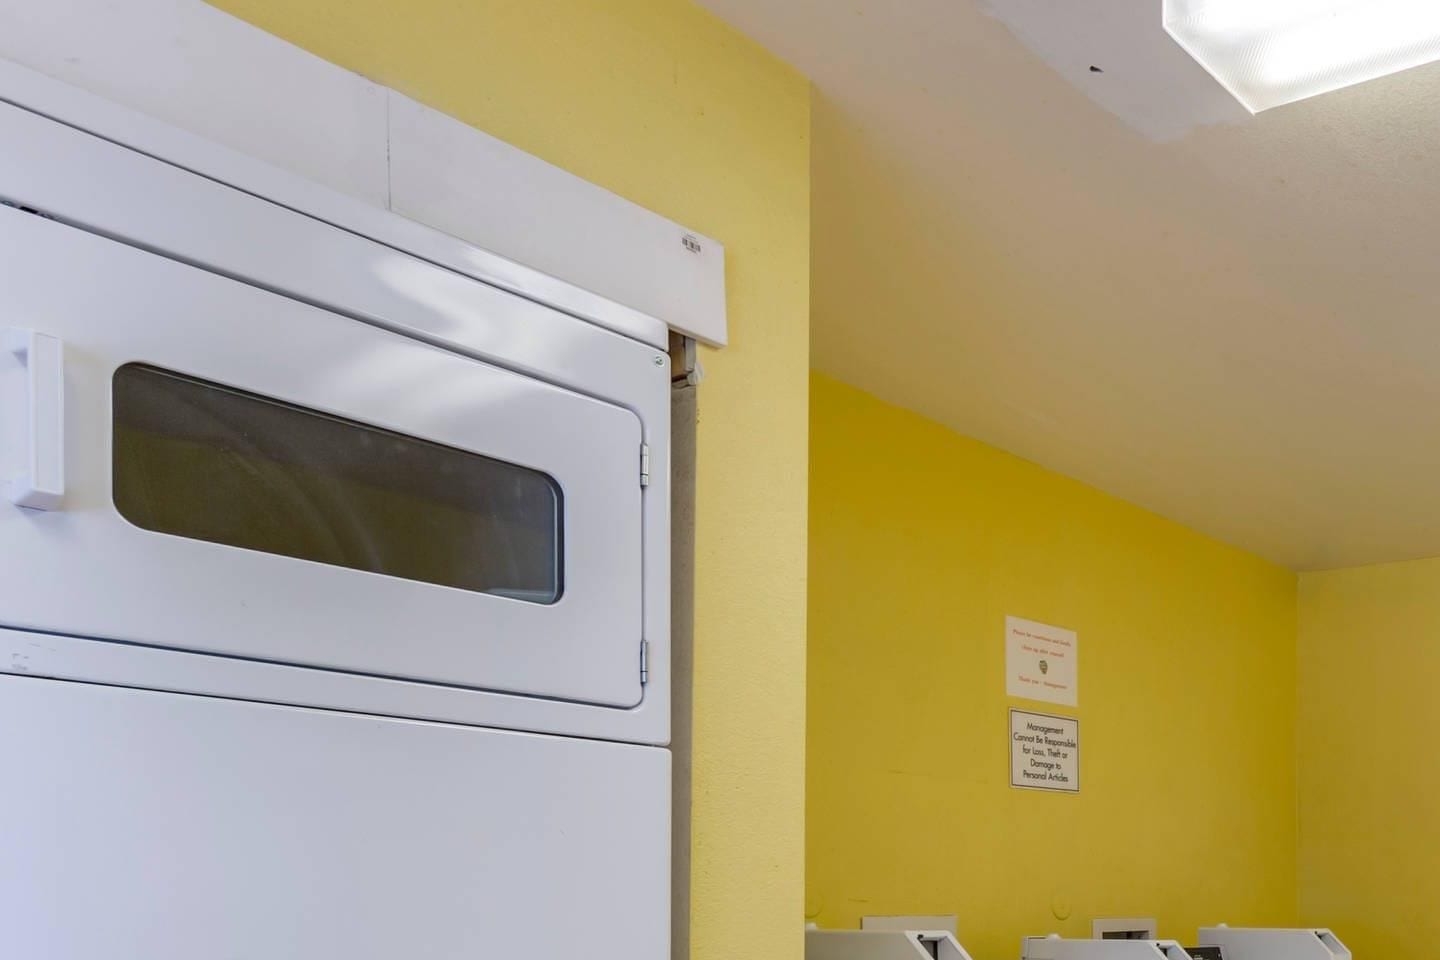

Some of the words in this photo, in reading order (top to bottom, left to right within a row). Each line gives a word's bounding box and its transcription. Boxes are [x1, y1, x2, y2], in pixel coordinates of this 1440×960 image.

[1027, 722, 1064, 735] Management
[1014, 731, 1035, 743] Cannot
[1036, 735, 1043, 744] Be
[1045, 736, 1077, 748] Responsible
[1023, 744, 1031, 754] for
[1047, 748, 1061, 758] Theft
[1030, 758, 1055, 771] Damage
[1023, 769, 1047, 780] Personal
[1048, 772, 1069, 782] Articles
